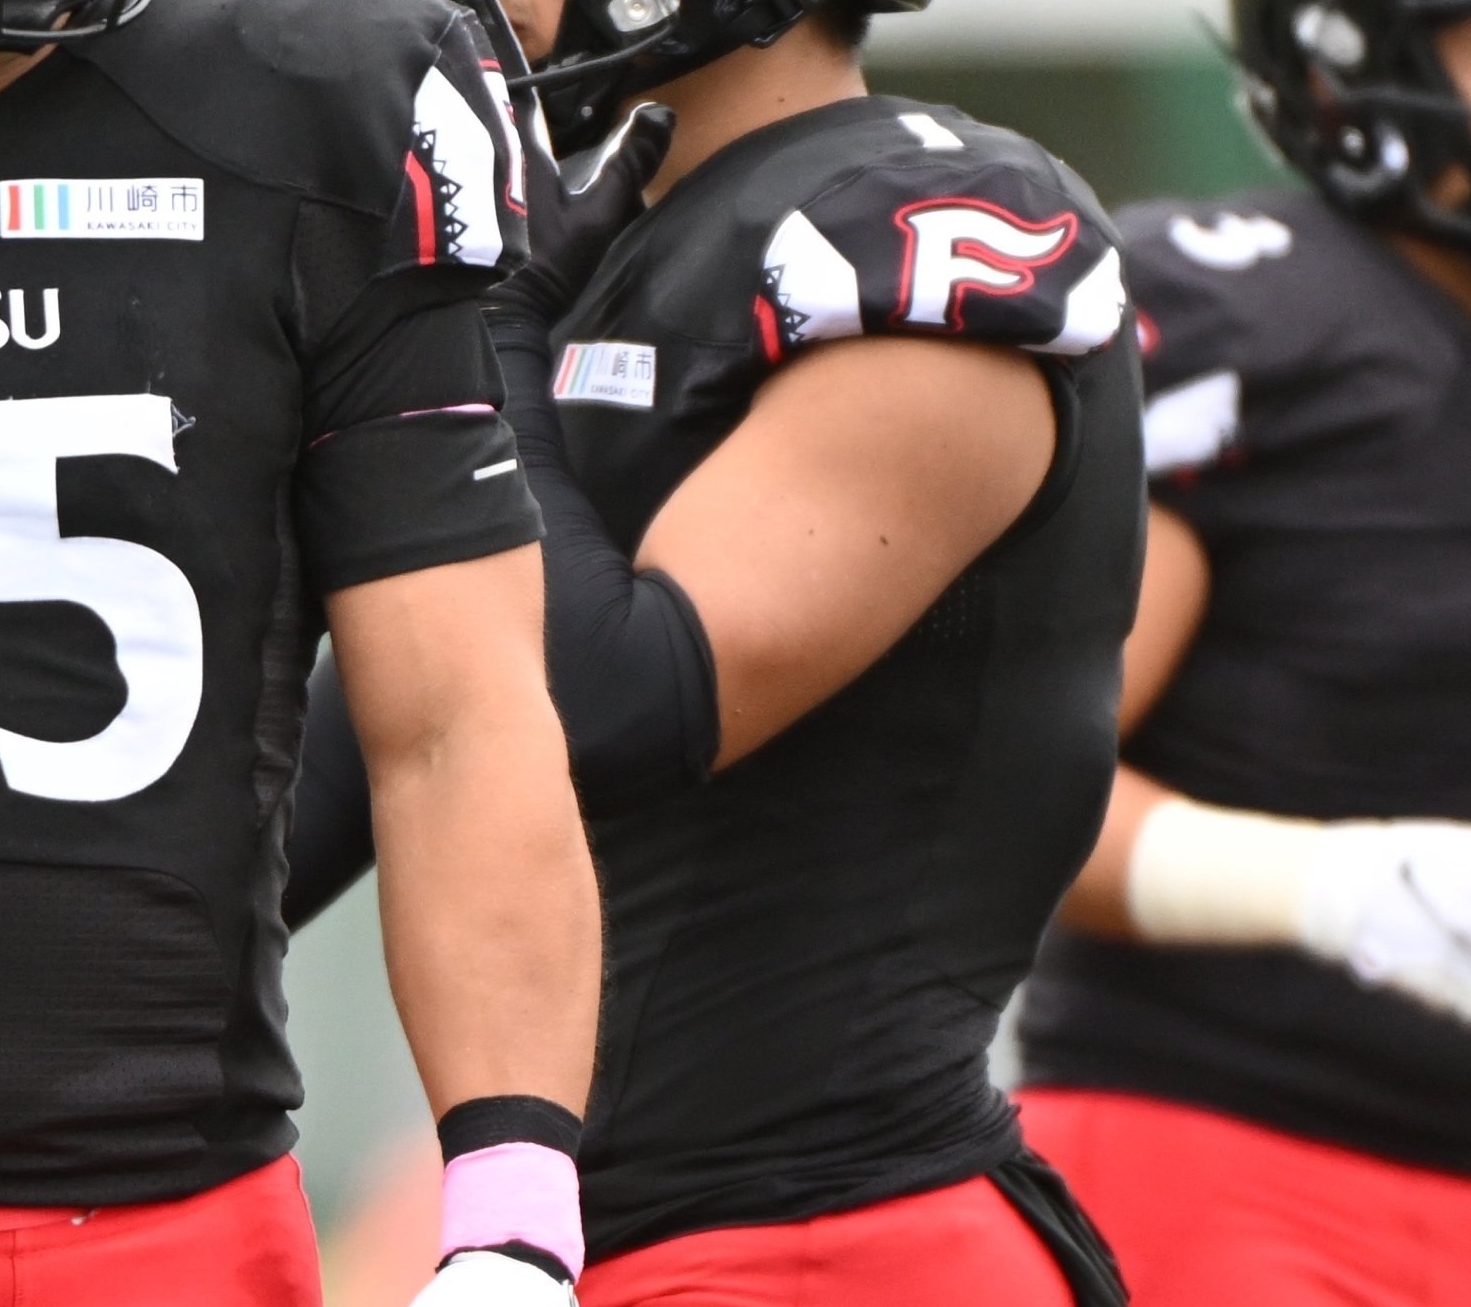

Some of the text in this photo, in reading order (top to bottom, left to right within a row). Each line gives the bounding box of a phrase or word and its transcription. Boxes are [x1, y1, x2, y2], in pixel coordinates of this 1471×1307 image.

[87, 185, 199, 212] 川崎市
[87, 221, 198, 231] KAWASAKI CITY
[889, 197, 1079, 333] F
